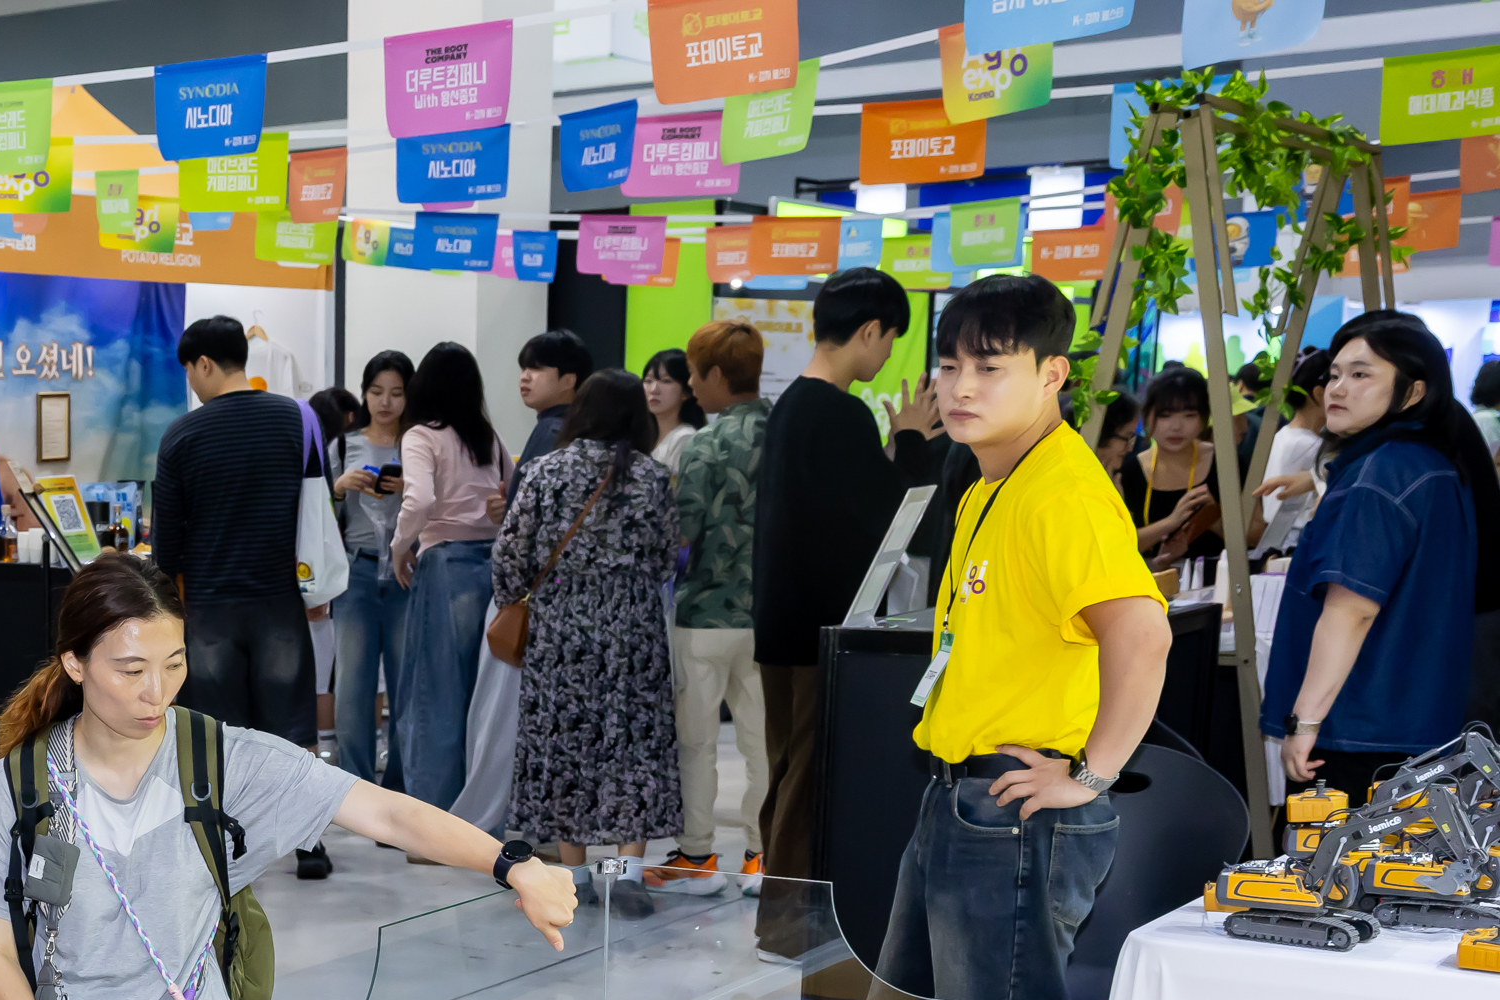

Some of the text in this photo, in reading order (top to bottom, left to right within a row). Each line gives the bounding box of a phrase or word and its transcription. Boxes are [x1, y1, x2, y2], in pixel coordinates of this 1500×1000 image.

[424, 52, 468, 64] COMPANY
[425, 43, 468, 57] THE ROOT
[686, 32, 764, 68] 포테이토교
[405, 60, 487, 93] 더루트컴퍼니
[962, 54, 1028, 99] expo
[178, 82, 239, 101] SYNODIA
[968, 90, 995, 102] Korea
[1408, 86, 1495, 115] 해태제과식품
[185, 103, 234, 129] 시노디아
[421, 141, 483, 155] SYNODIA
[890, 135, 955, 159] 포테이토교
[428, 158, 477, 179] 시노디아
[135, 204, 159, 226] gri
[121, 249, 201, 267] POTATO RELIGION
[12, 341, 95, 381] 오셨네!
